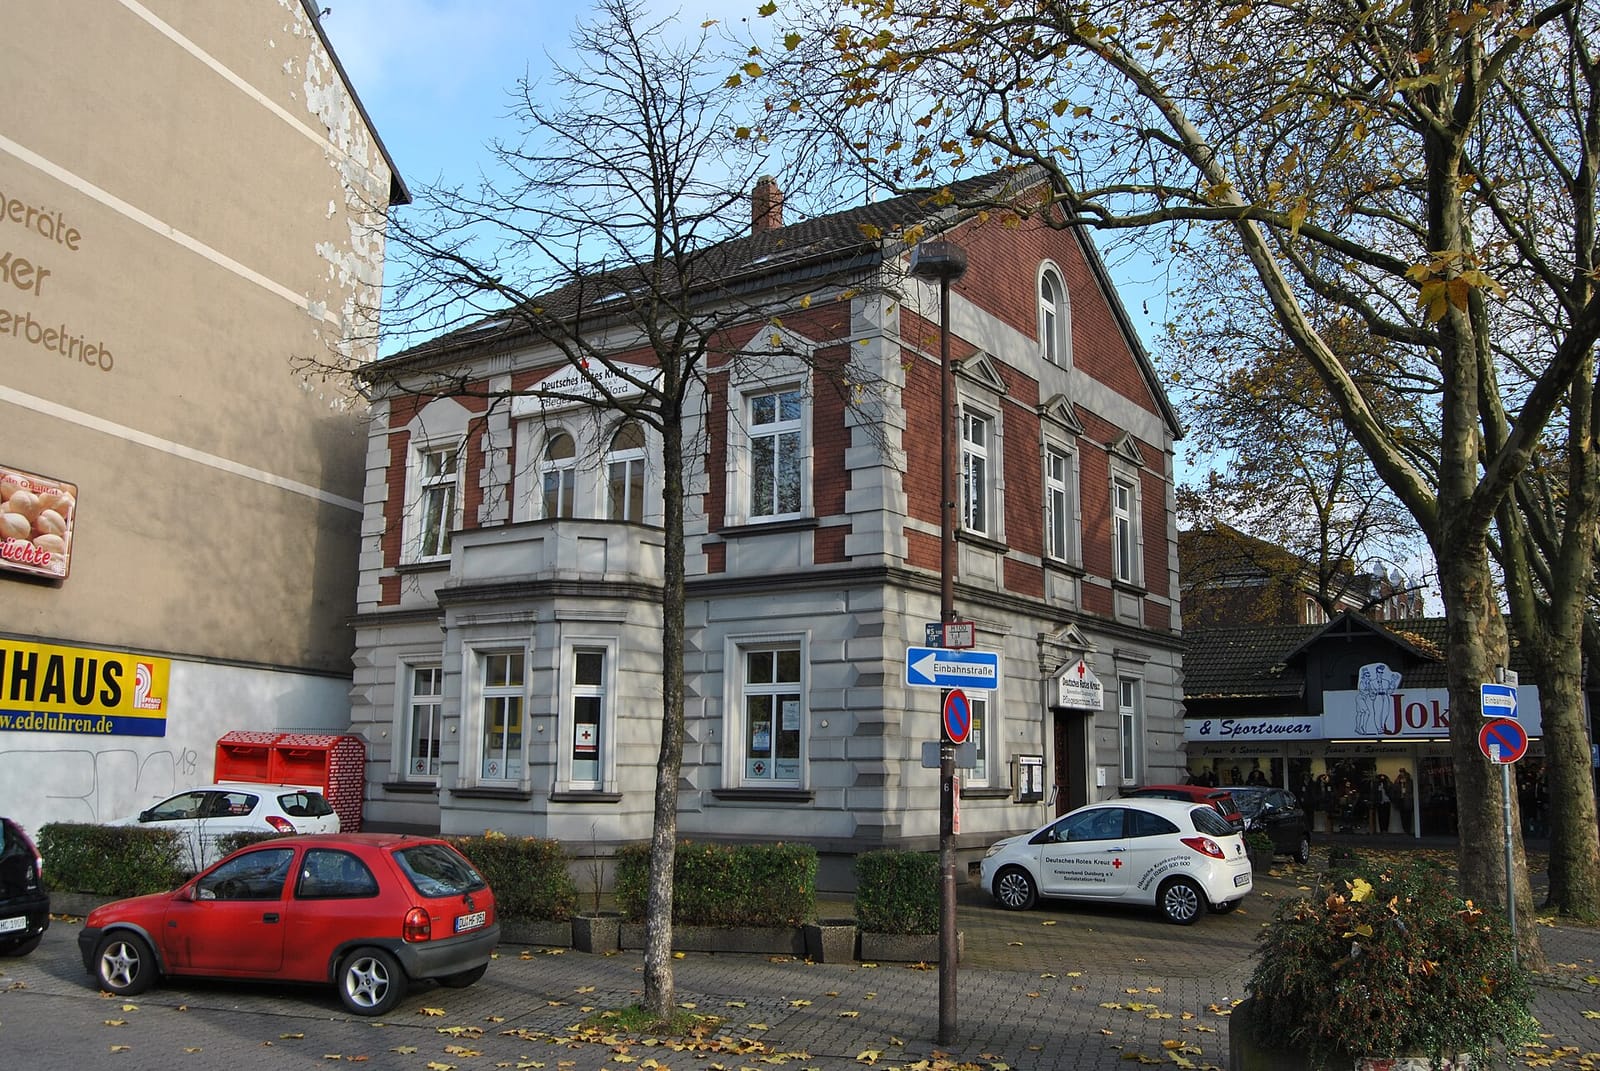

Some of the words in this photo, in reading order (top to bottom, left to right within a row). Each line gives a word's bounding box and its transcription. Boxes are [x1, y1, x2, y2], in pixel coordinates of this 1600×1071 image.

[541, 376, 579, 391] Deutsches
[933, 663, 993, 676] Einbahnstraße
[1199, 720, 1212, 736] &
[1220, 719, 1312, 739] Sportswear
